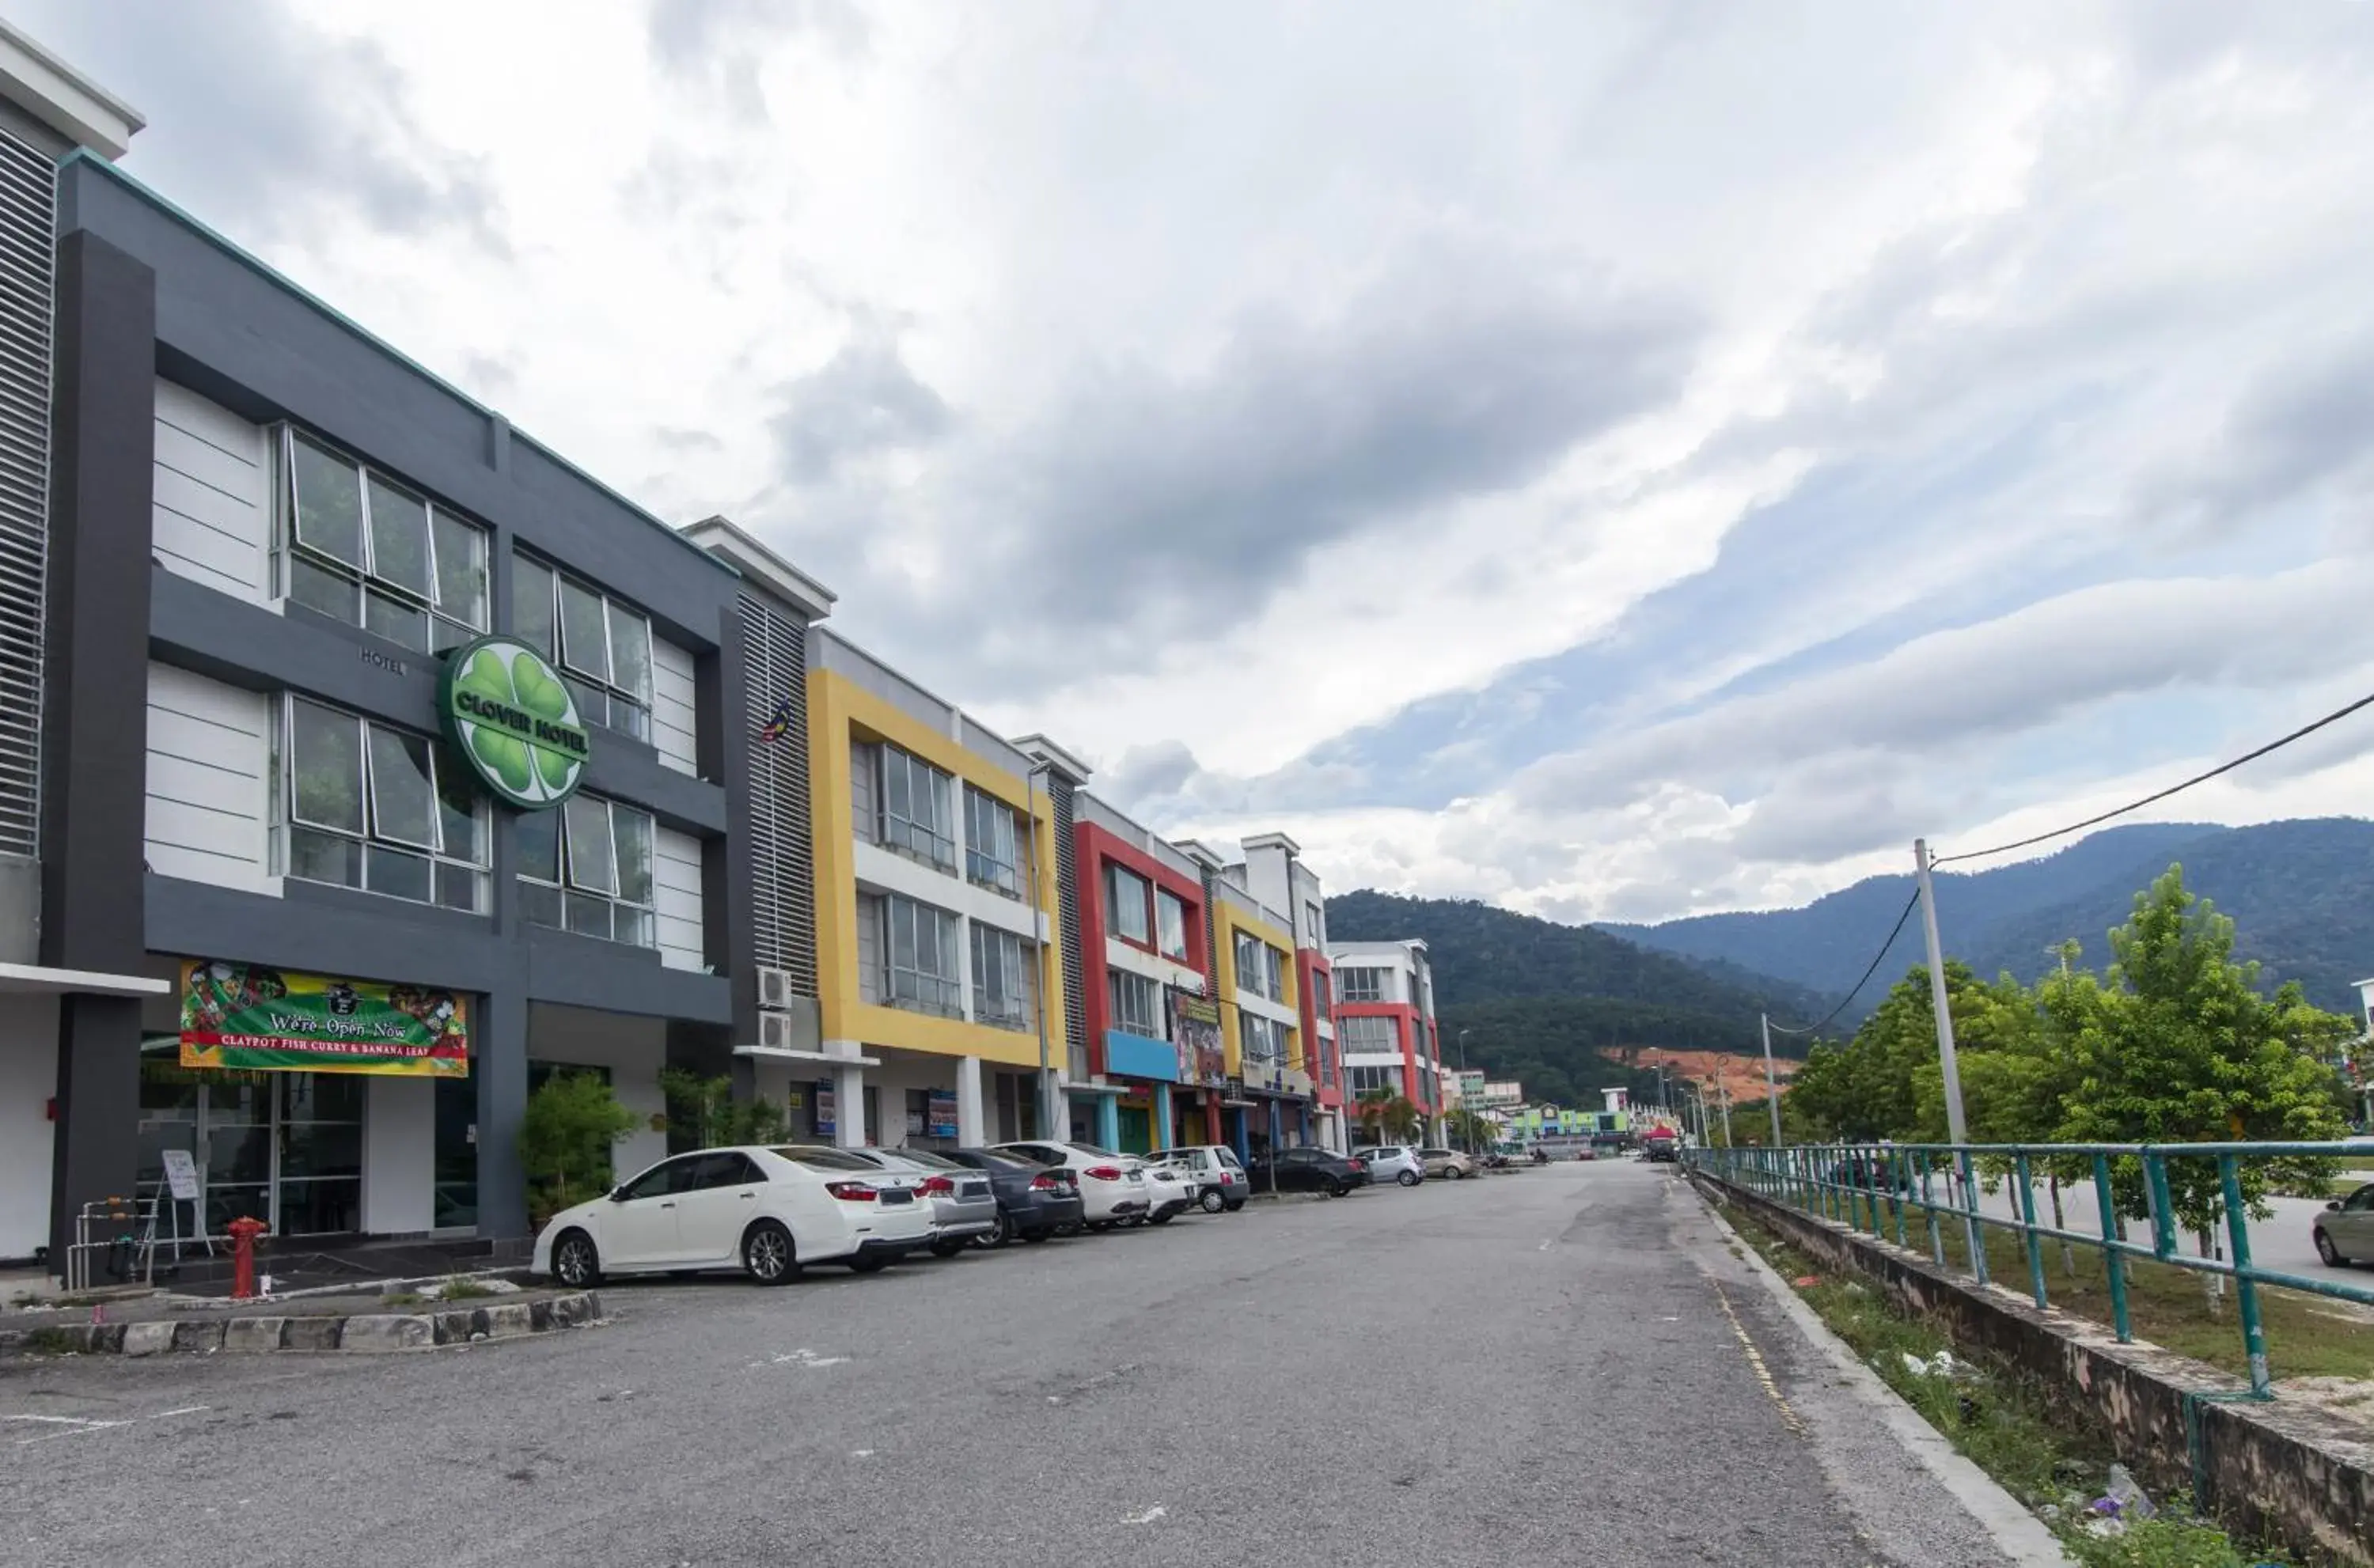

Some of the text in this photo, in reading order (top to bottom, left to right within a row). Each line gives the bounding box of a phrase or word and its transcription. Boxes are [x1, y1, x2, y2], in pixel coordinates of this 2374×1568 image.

[361, 647, 405, 676] HOTEL
[457, 691, 588, 754] CLOVER HOTEL
[327, 1018, 365, 1039] Open
[373, 1021, 406, 1038] Now
[221, 1034, 429, 1057] CLAYPOT FISH CURRY & BANANA LEAF
